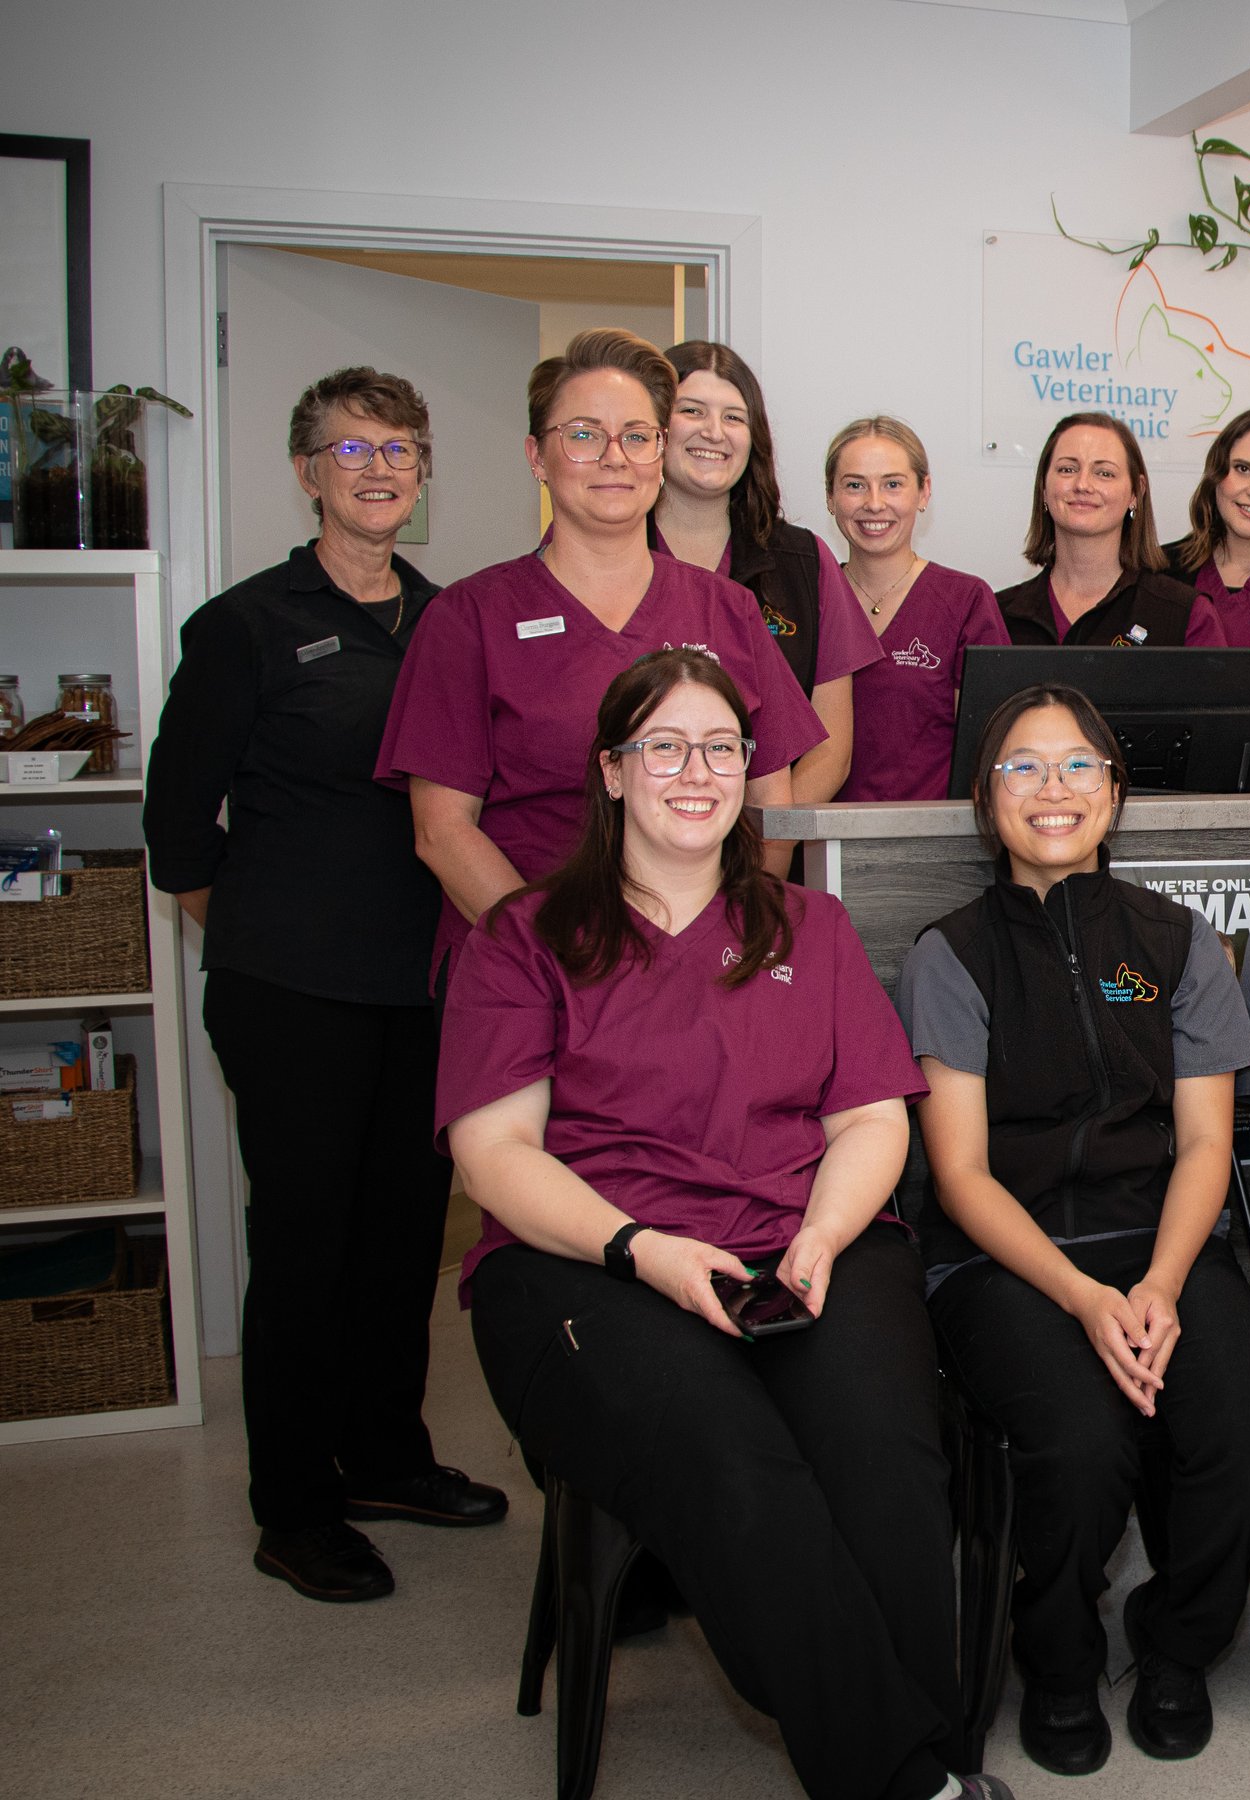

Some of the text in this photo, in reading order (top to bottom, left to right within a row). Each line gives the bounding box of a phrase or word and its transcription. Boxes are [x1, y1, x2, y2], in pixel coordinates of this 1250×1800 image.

[1013, 341, 1113, 371] Gawler
[1031, 374, 1178, 412] Veterinary
[1145, 878, 1208, 894] WE'RE
[1105, 994, 1133, 1002] Services
